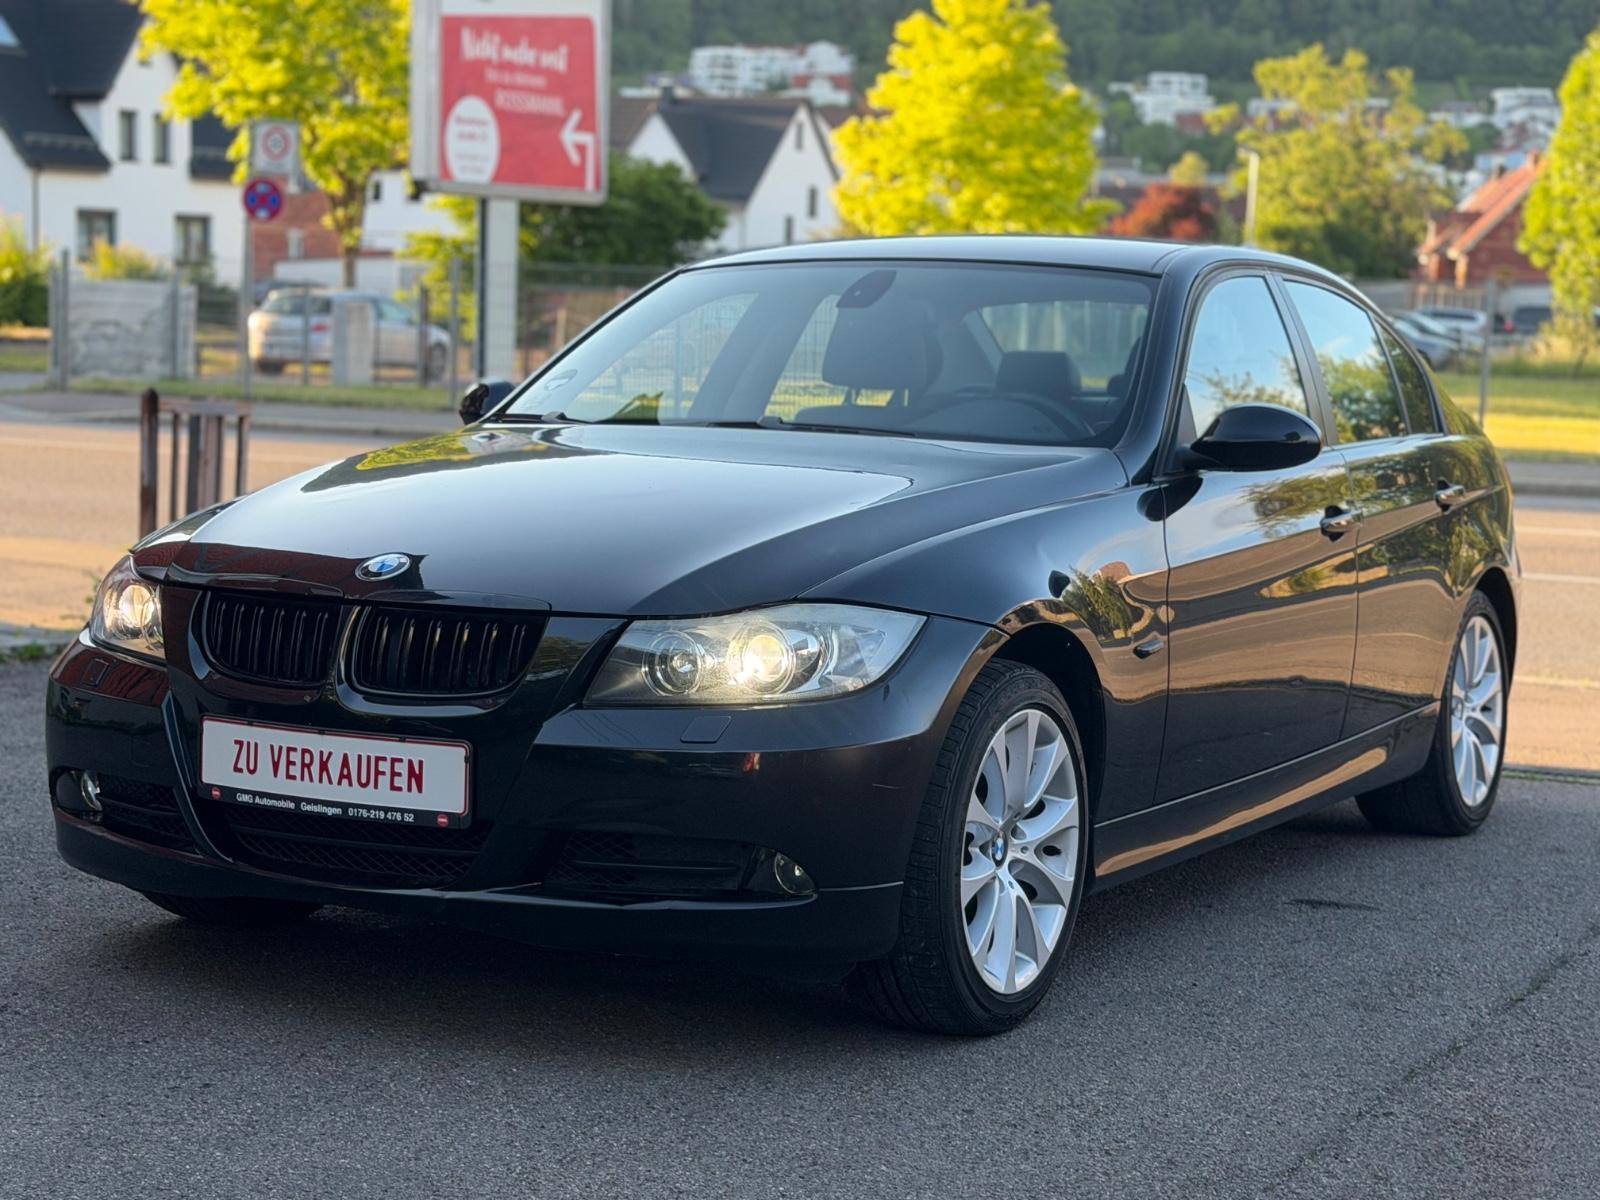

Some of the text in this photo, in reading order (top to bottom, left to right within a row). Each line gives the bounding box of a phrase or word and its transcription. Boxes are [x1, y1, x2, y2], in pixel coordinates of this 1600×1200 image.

[233, 739, 424, 794] ZU VERKAUFEN
[236, 793, 253, 804] GMG
[254, 795, 295, 810] Automobile
[300, 802, 342, 815] Geislingen
[386, 811, 402, 821] 476
[403, 813, 415, 822] 52
